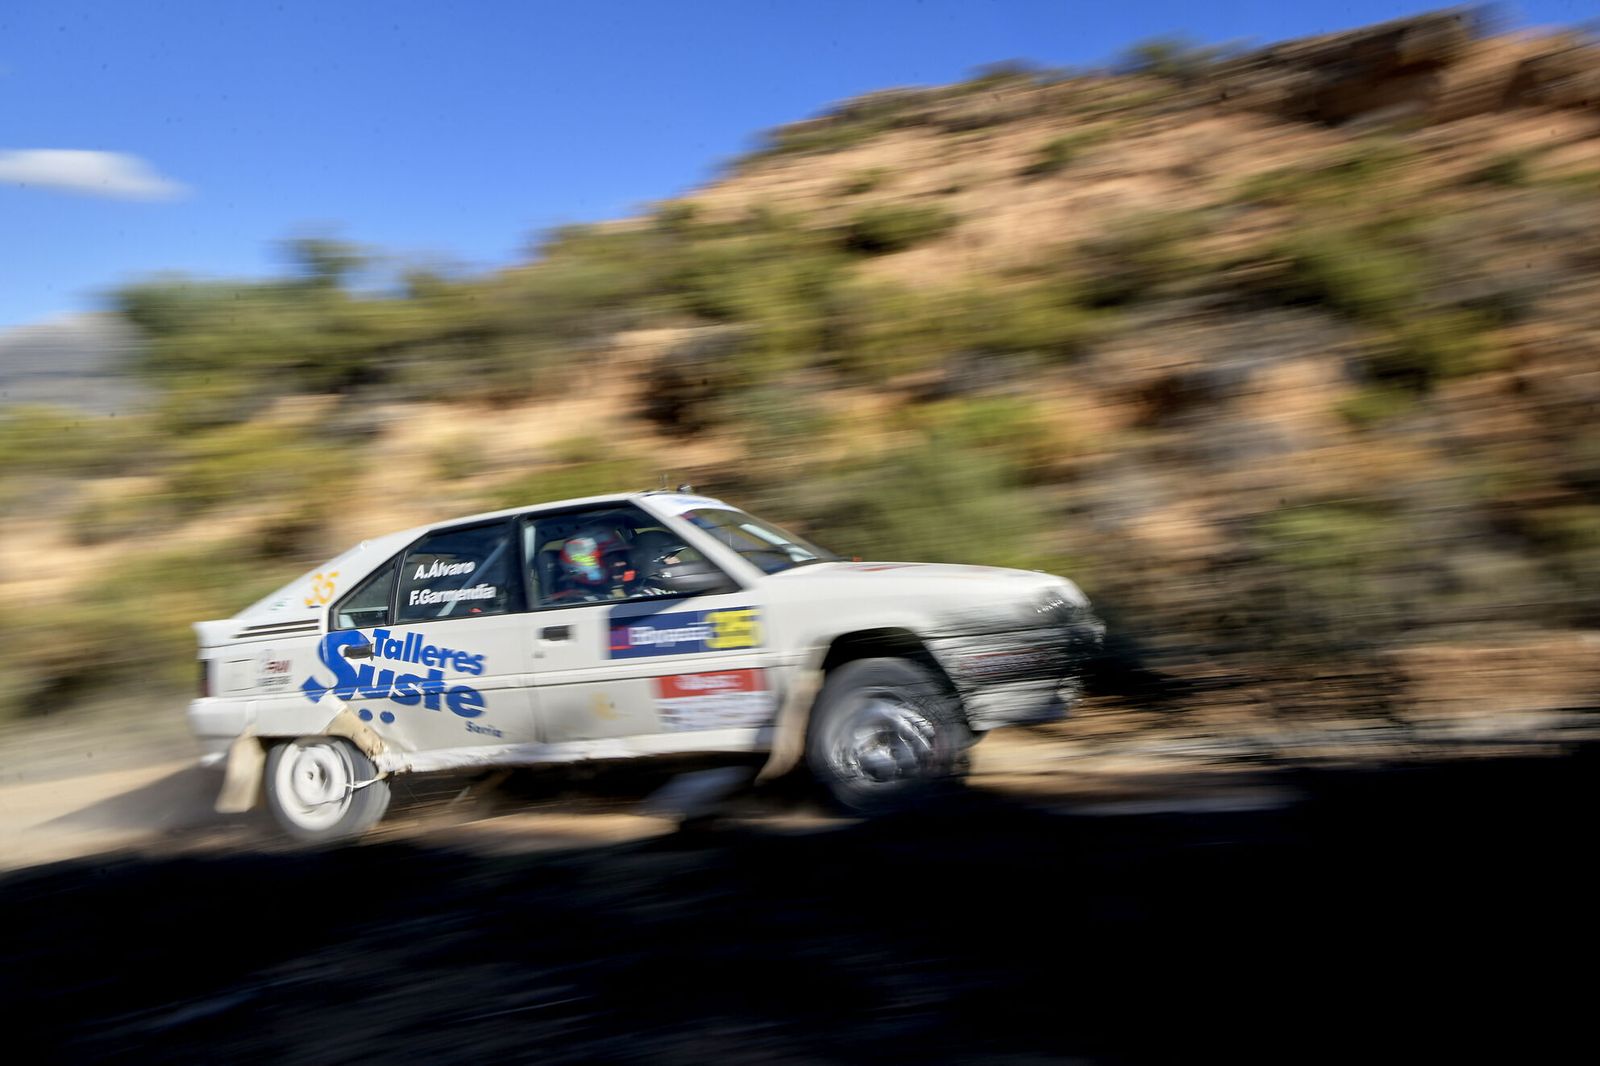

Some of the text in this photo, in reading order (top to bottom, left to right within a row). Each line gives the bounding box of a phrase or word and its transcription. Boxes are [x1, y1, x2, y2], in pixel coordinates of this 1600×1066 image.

[413, 559, 476, 580] A.Álvaro
[299, 630, 487, 719] Suste
[372, 628, 485, 676] Talleres
